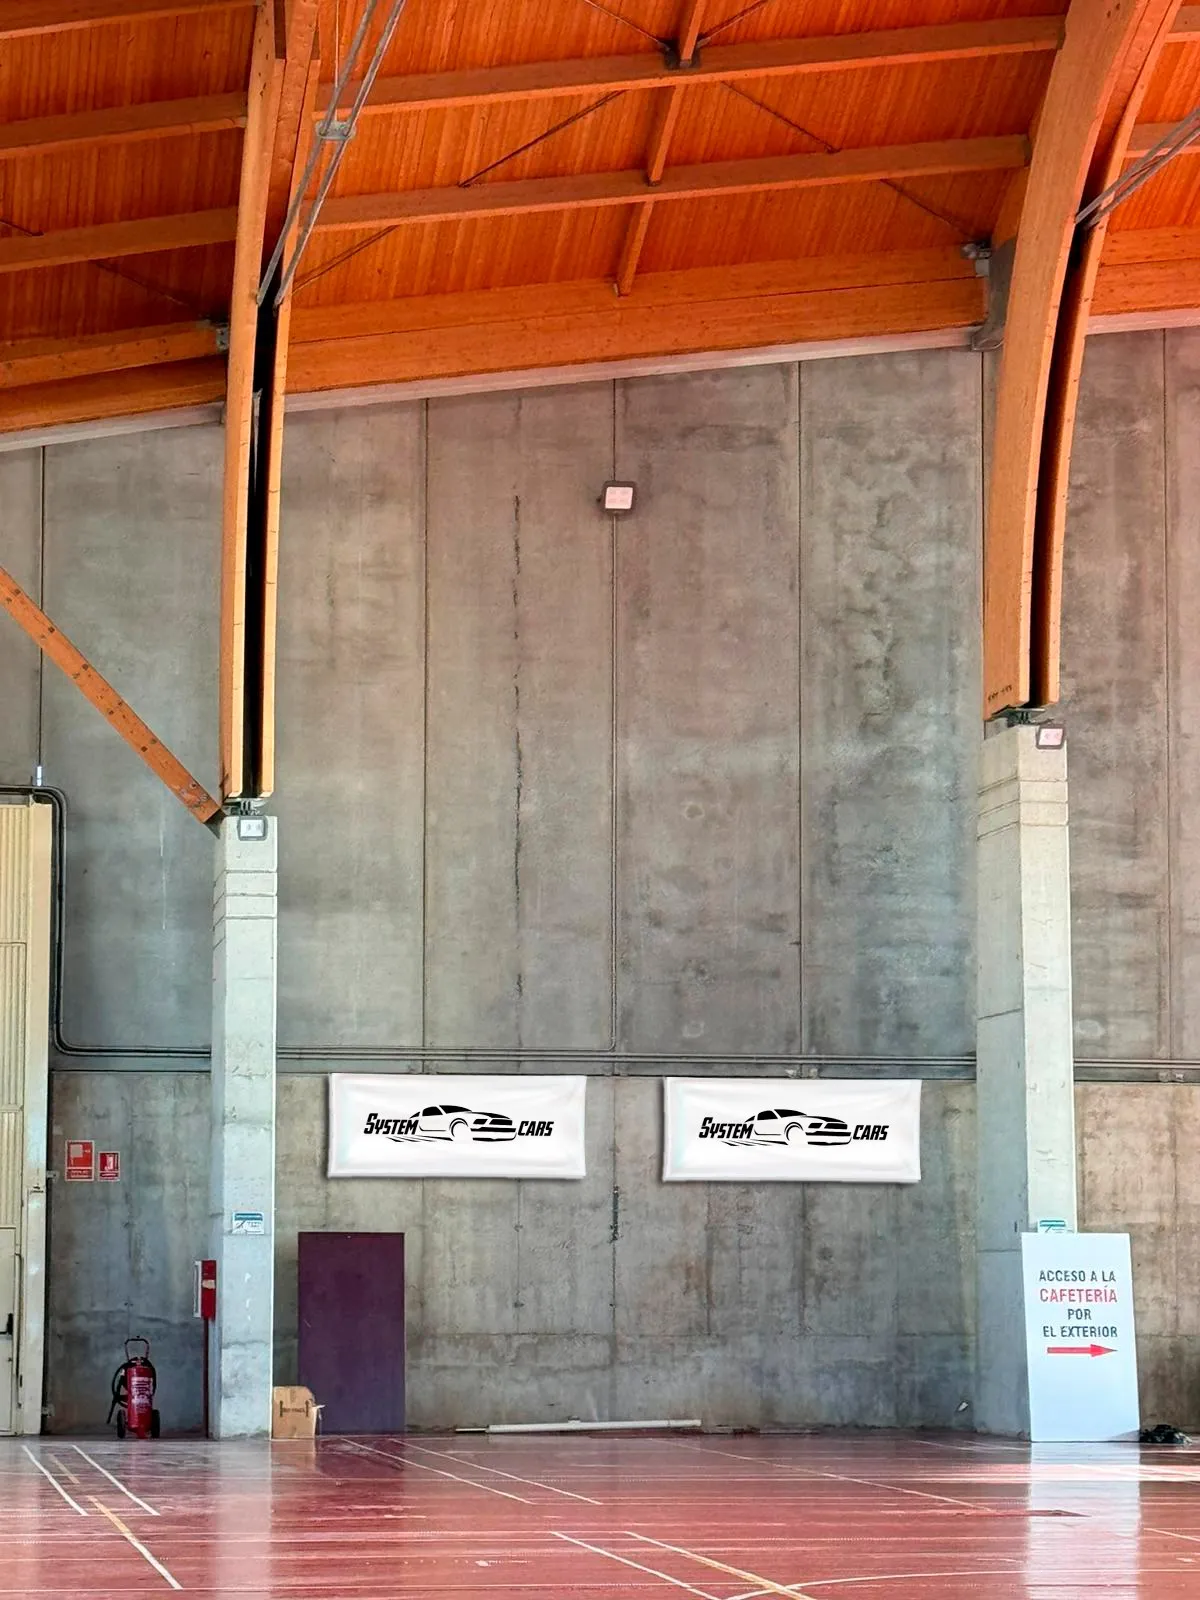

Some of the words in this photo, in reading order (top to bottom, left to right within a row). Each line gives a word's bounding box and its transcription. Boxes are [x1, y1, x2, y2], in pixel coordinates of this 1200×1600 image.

[518, 1120, 555, 1137] CARS
[853, 1124, 890, 1141] CARS
[1039, 1270, 1086, 1282] ACCESO
[1090, 1270, 1098, 1282] A
[1101, 1270, 1117, 1282] LA
[1039, 1285, 1118, 1303] CAFETERÍA
[1067, 1308, 1092, 1321] POR
[1042, 1325, 1057, 1338] EL
[1060, 1325, 1118, 1338] EXTERIOR
